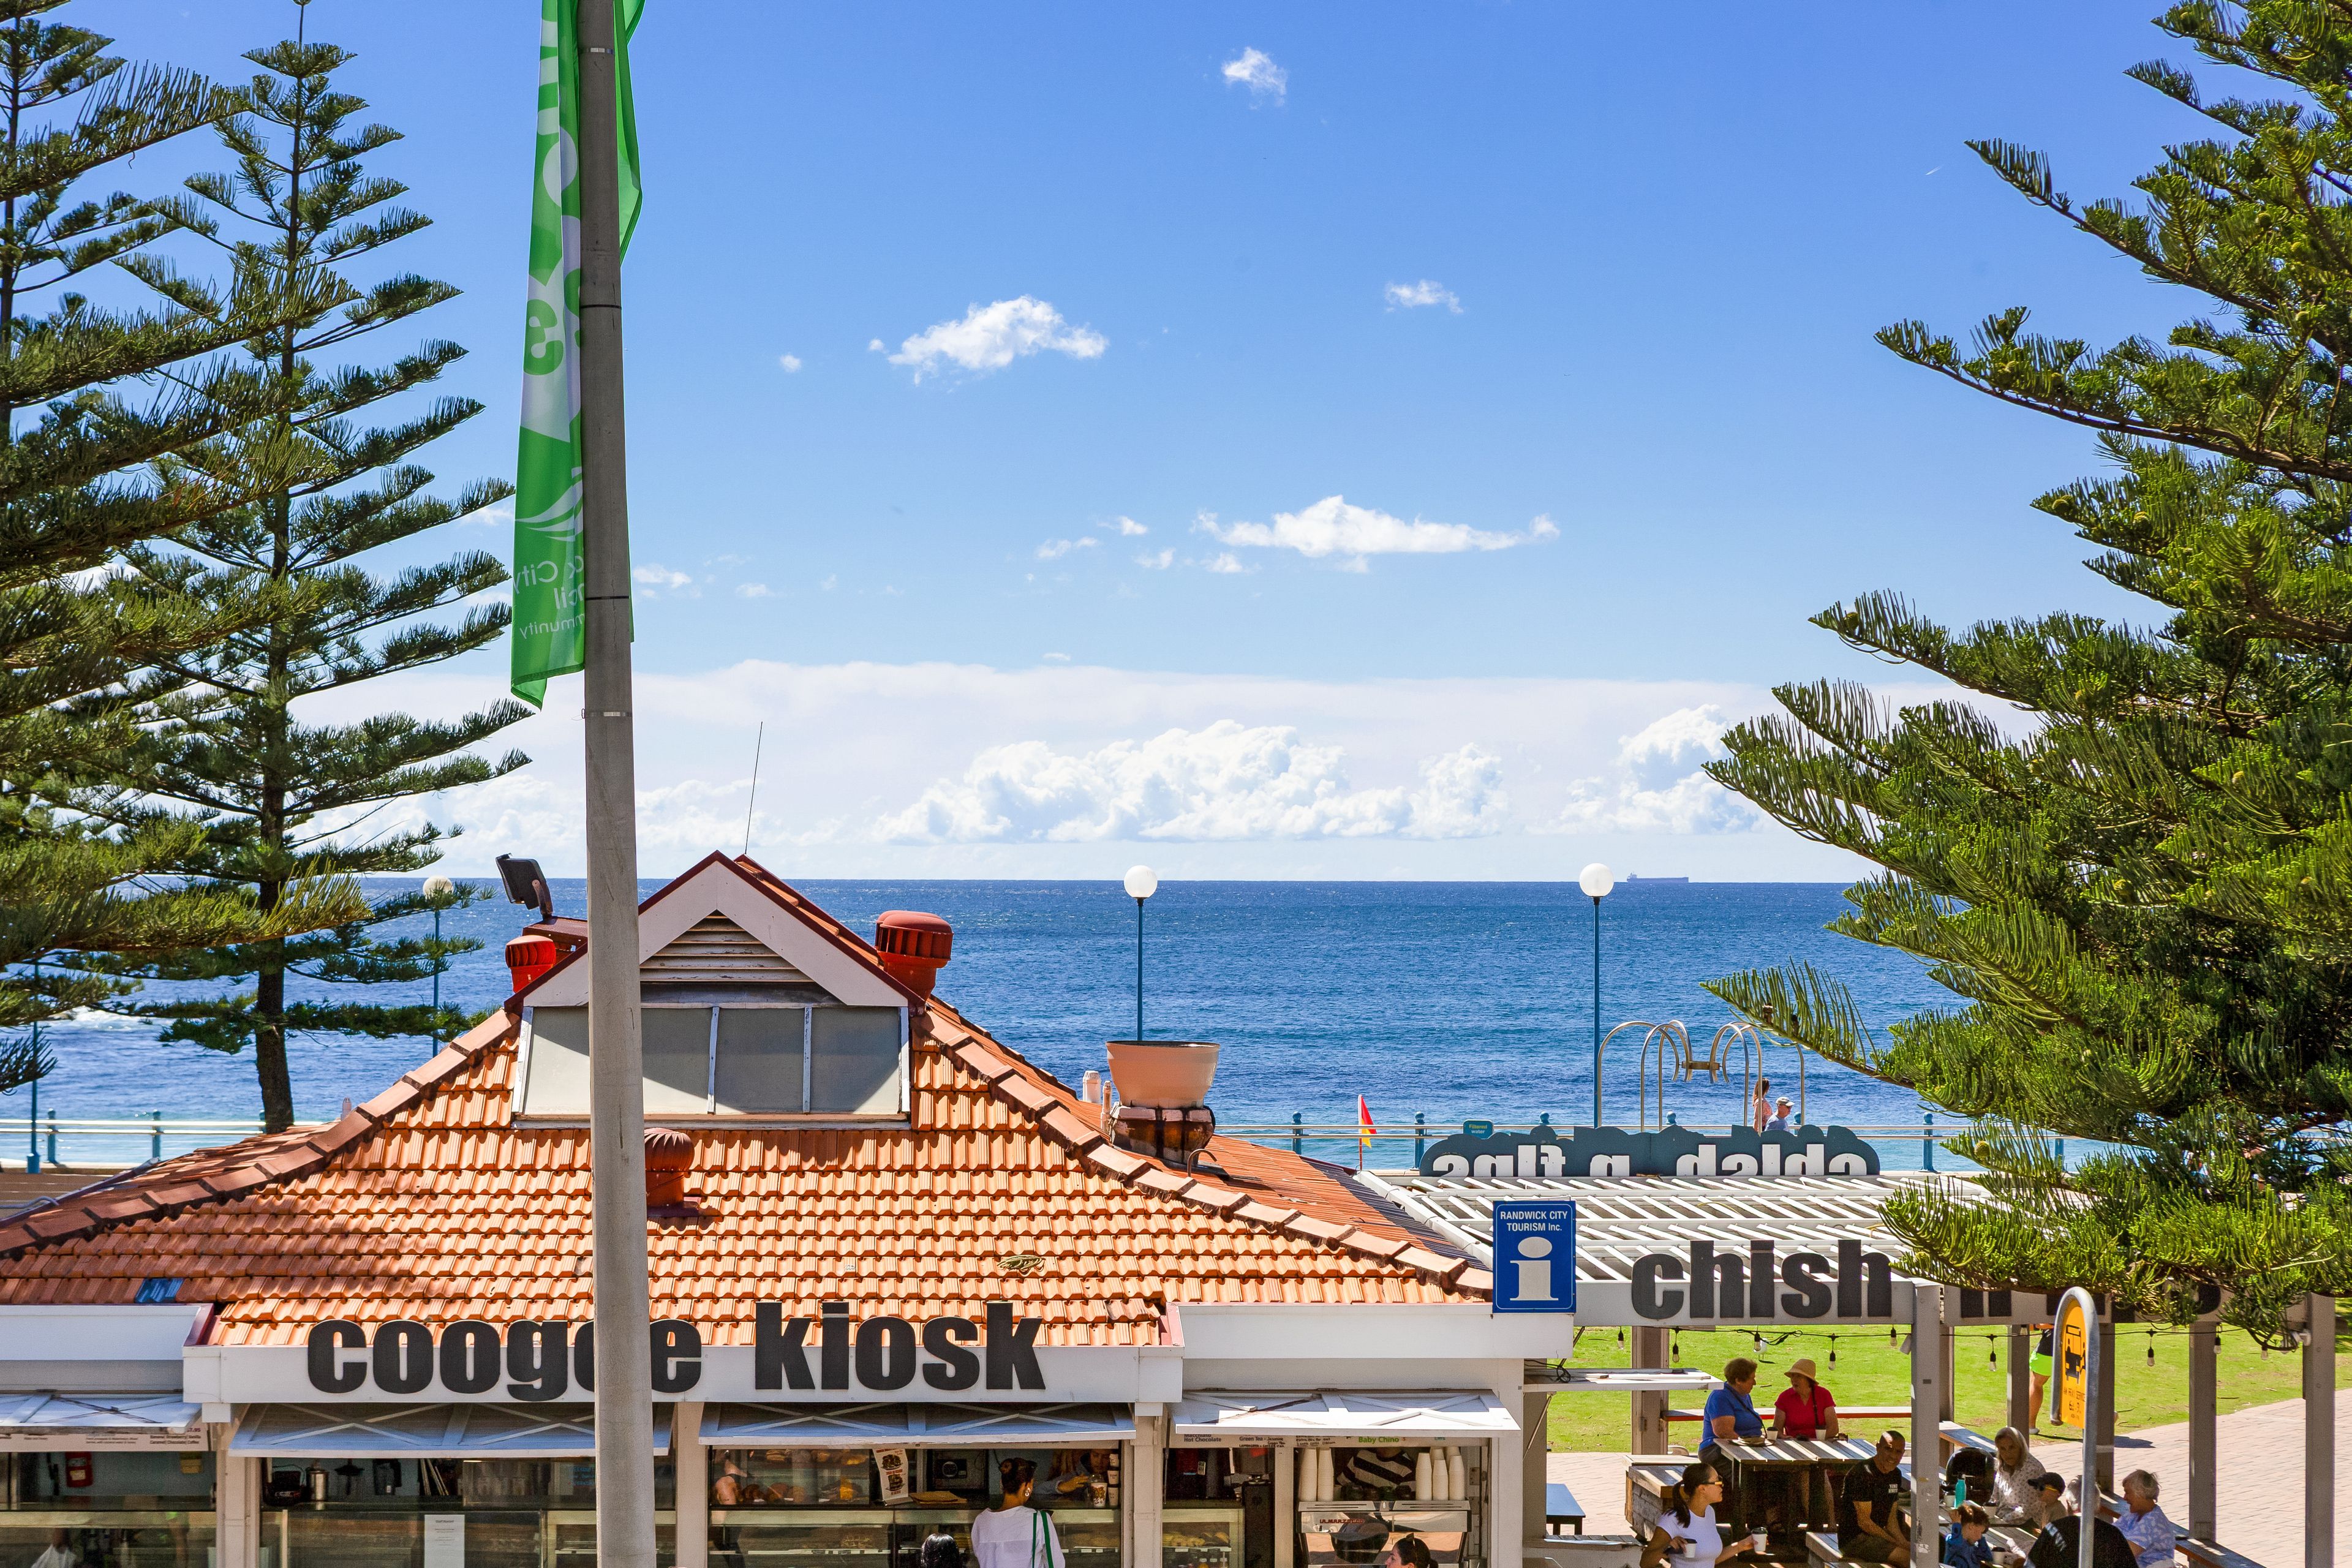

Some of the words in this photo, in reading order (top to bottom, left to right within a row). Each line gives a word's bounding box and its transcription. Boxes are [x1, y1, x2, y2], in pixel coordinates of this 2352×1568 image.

[1500, 1211, 1547, 1220] RANDWICK
[1549, 1210, 1568, 1220] CITY
[1506, 1223, 1546, 1232] TOURISM
[1548, 1223, 1562, 1231] Inc.
[1631, 1240, 1893, 1319] chish
[755, 1301, 1046, 1390] kiosk
